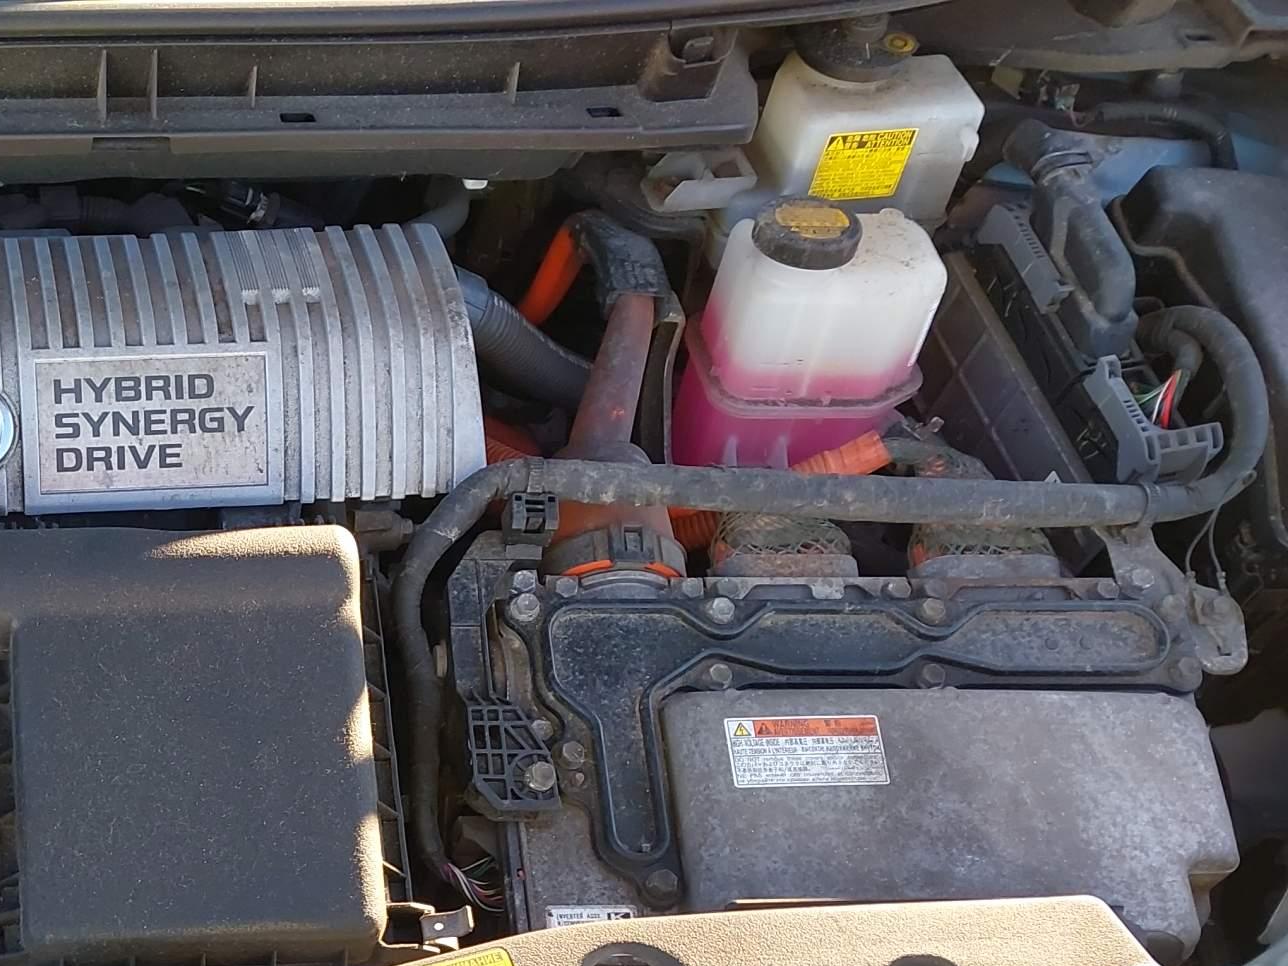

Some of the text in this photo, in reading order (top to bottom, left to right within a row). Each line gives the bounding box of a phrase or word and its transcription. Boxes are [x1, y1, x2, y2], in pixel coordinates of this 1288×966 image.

[864, 139, 910, 149] ATTENTION
[877, 130, 913, 141] CAUTION
[53, 373, 214, 405] HYBRID
[55, 406, 255, 439] SYNERGY
[56, 443, 183, 473] DRIVE
